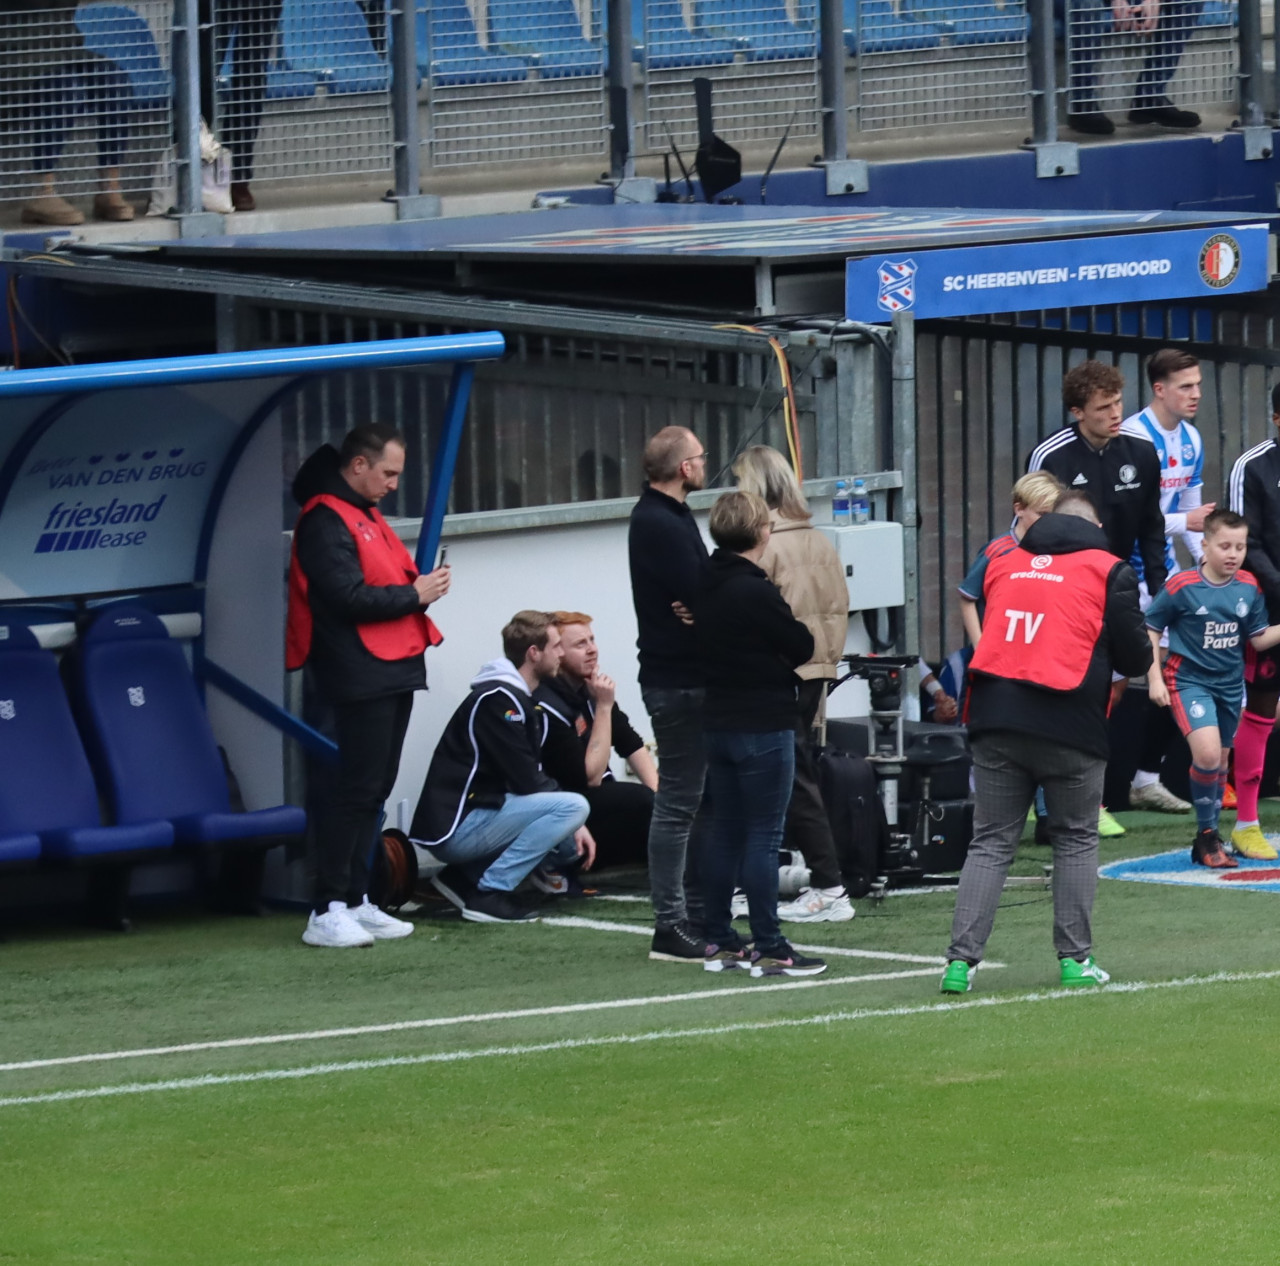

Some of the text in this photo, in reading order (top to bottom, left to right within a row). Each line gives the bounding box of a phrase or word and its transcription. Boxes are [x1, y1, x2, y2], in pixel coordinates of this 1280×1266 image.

[943, 274, 965, 291] SC
[966, 267, 1069, 290] HEERENVEEN
[1077, 259, 1172, 282] FEYENOORD
[49, 461, 207, 489] VAN DEN BRUG
[43, 494, 167, 530] friesland
[91, 529, 147, 549] lease
[1009, 570, 1065, 583] eredivisie
[1004, 608, 1046, 645] TV
[1204, 621, 1239, 636] Euro
